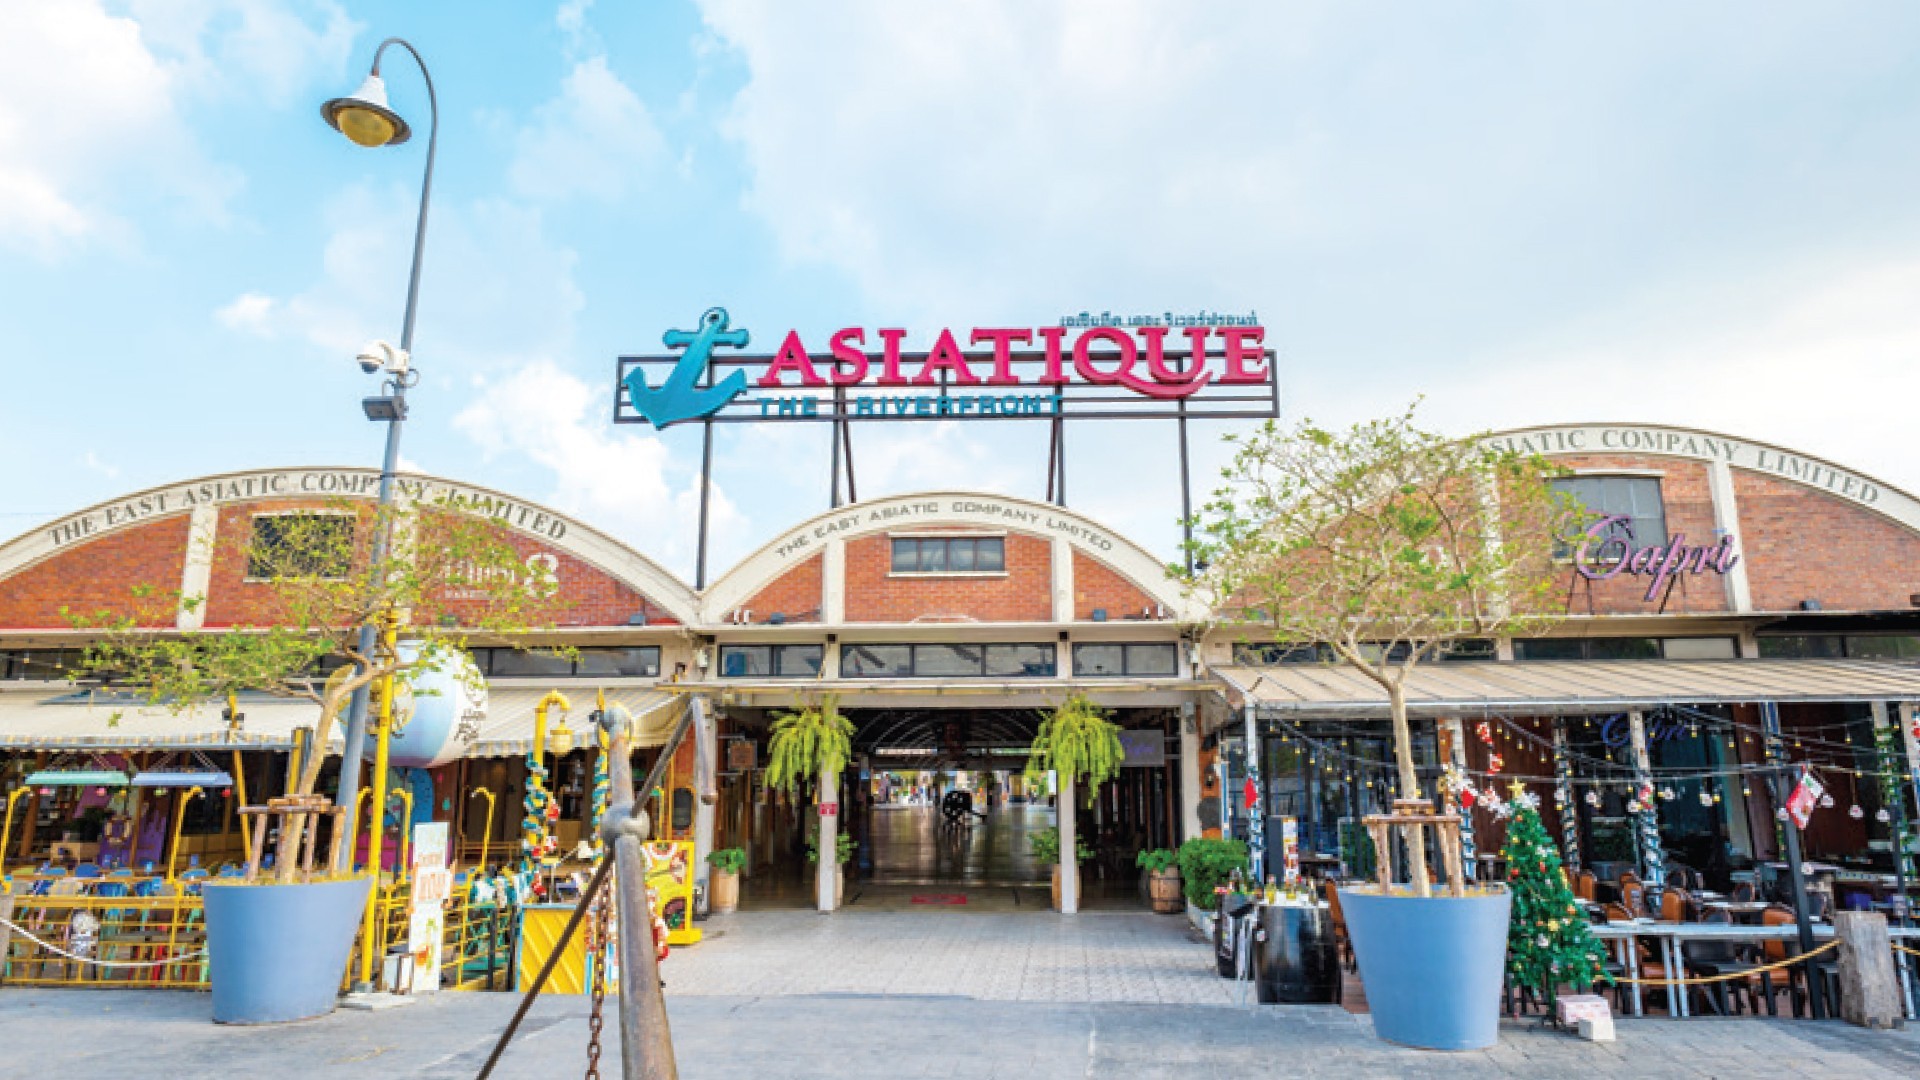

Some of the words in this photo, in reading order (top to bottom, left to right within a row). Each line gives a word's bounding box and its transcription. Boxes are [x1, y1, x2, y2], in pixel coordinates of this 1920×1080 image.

[757, 326, 1268, 399] ASIATIQUE
[757, 396, 819, 417] THE
[856, 394, 1063, 416] RIVERFRONT
[1602, 429, 1740, 462] COMPANY
[1757, 450, 1879, 503] LIMITED
[48, 516, 98, 545] THE
[104, 493, 169, 526] EAST
[182, 474, 287, 506] ASIATIC
[814, 514, 860, 539] EAST
[868, 502, 939, 522] ASIATIC
[952, 501, 1040, 524] COMPANY
[1554, 510, 1740, 602] Capri
